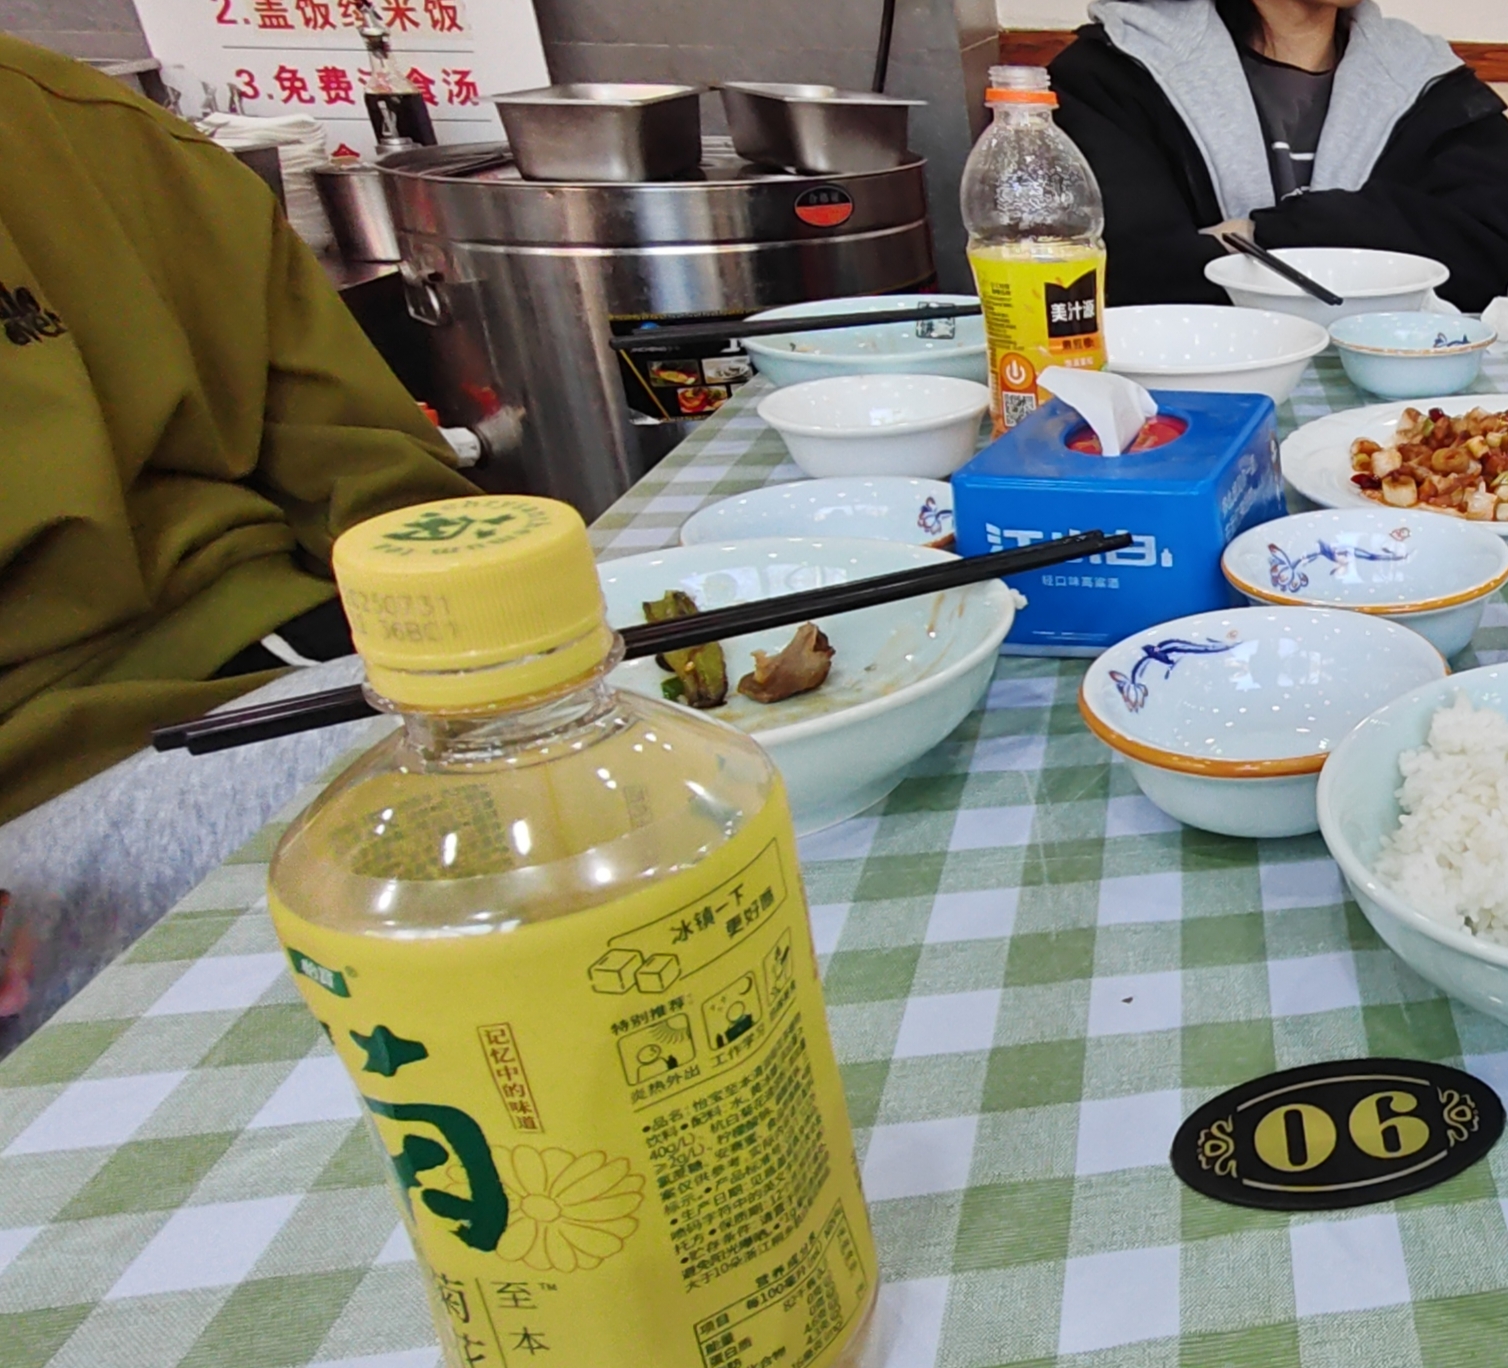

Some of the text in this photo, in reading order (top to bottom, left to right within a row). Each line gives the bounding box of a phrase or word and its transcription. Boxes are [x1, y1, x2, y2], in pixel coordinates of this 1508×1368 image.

[235, 65, 481, 106] 3.免费食汤
[1050, 299, 1095, 322] 美汁源
[985, 522, 1157, 567] 江白
[670, 883, 744, 945] 冰镇一下
[484, 1027, 540, 1131] 记忆中的味道
[630, 1063, 701, 1103] 炎热外出
[1253, 1089, 1430, 1173] 06
